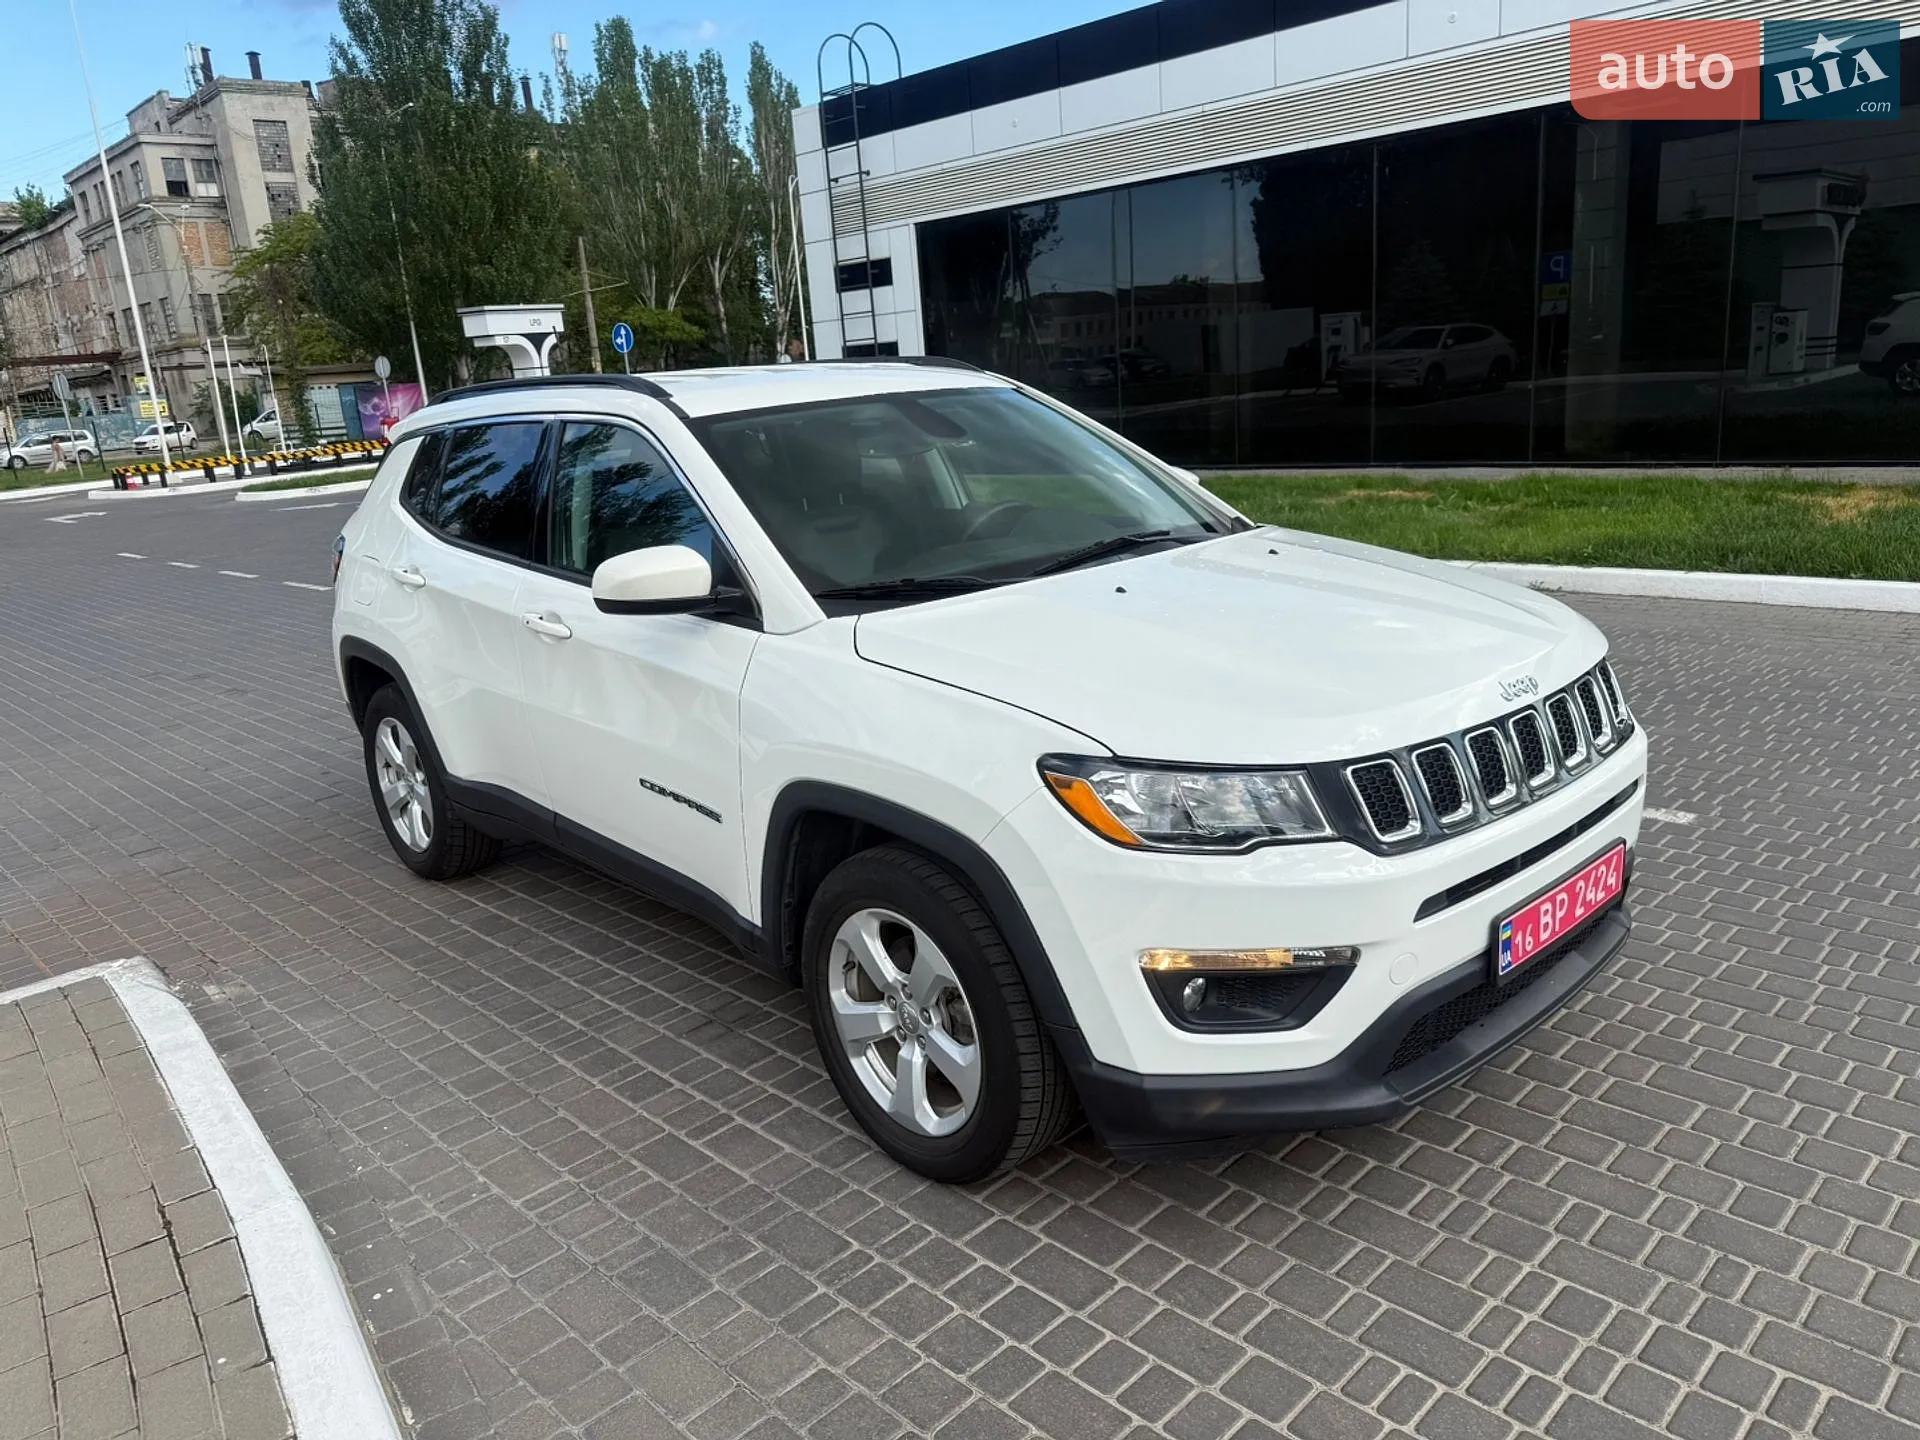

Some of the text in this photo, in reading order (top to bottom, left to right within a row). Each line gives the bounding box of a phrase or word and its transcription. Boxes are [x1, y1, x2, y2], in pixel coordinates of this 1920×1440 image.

[1498, 674, 1539, 702] Jeep
[639, 777, 723, 824] COMPASS
[1514, 854, 1618, 957] 16 BP 2424
[1501, 949, 1512, 967] UA
